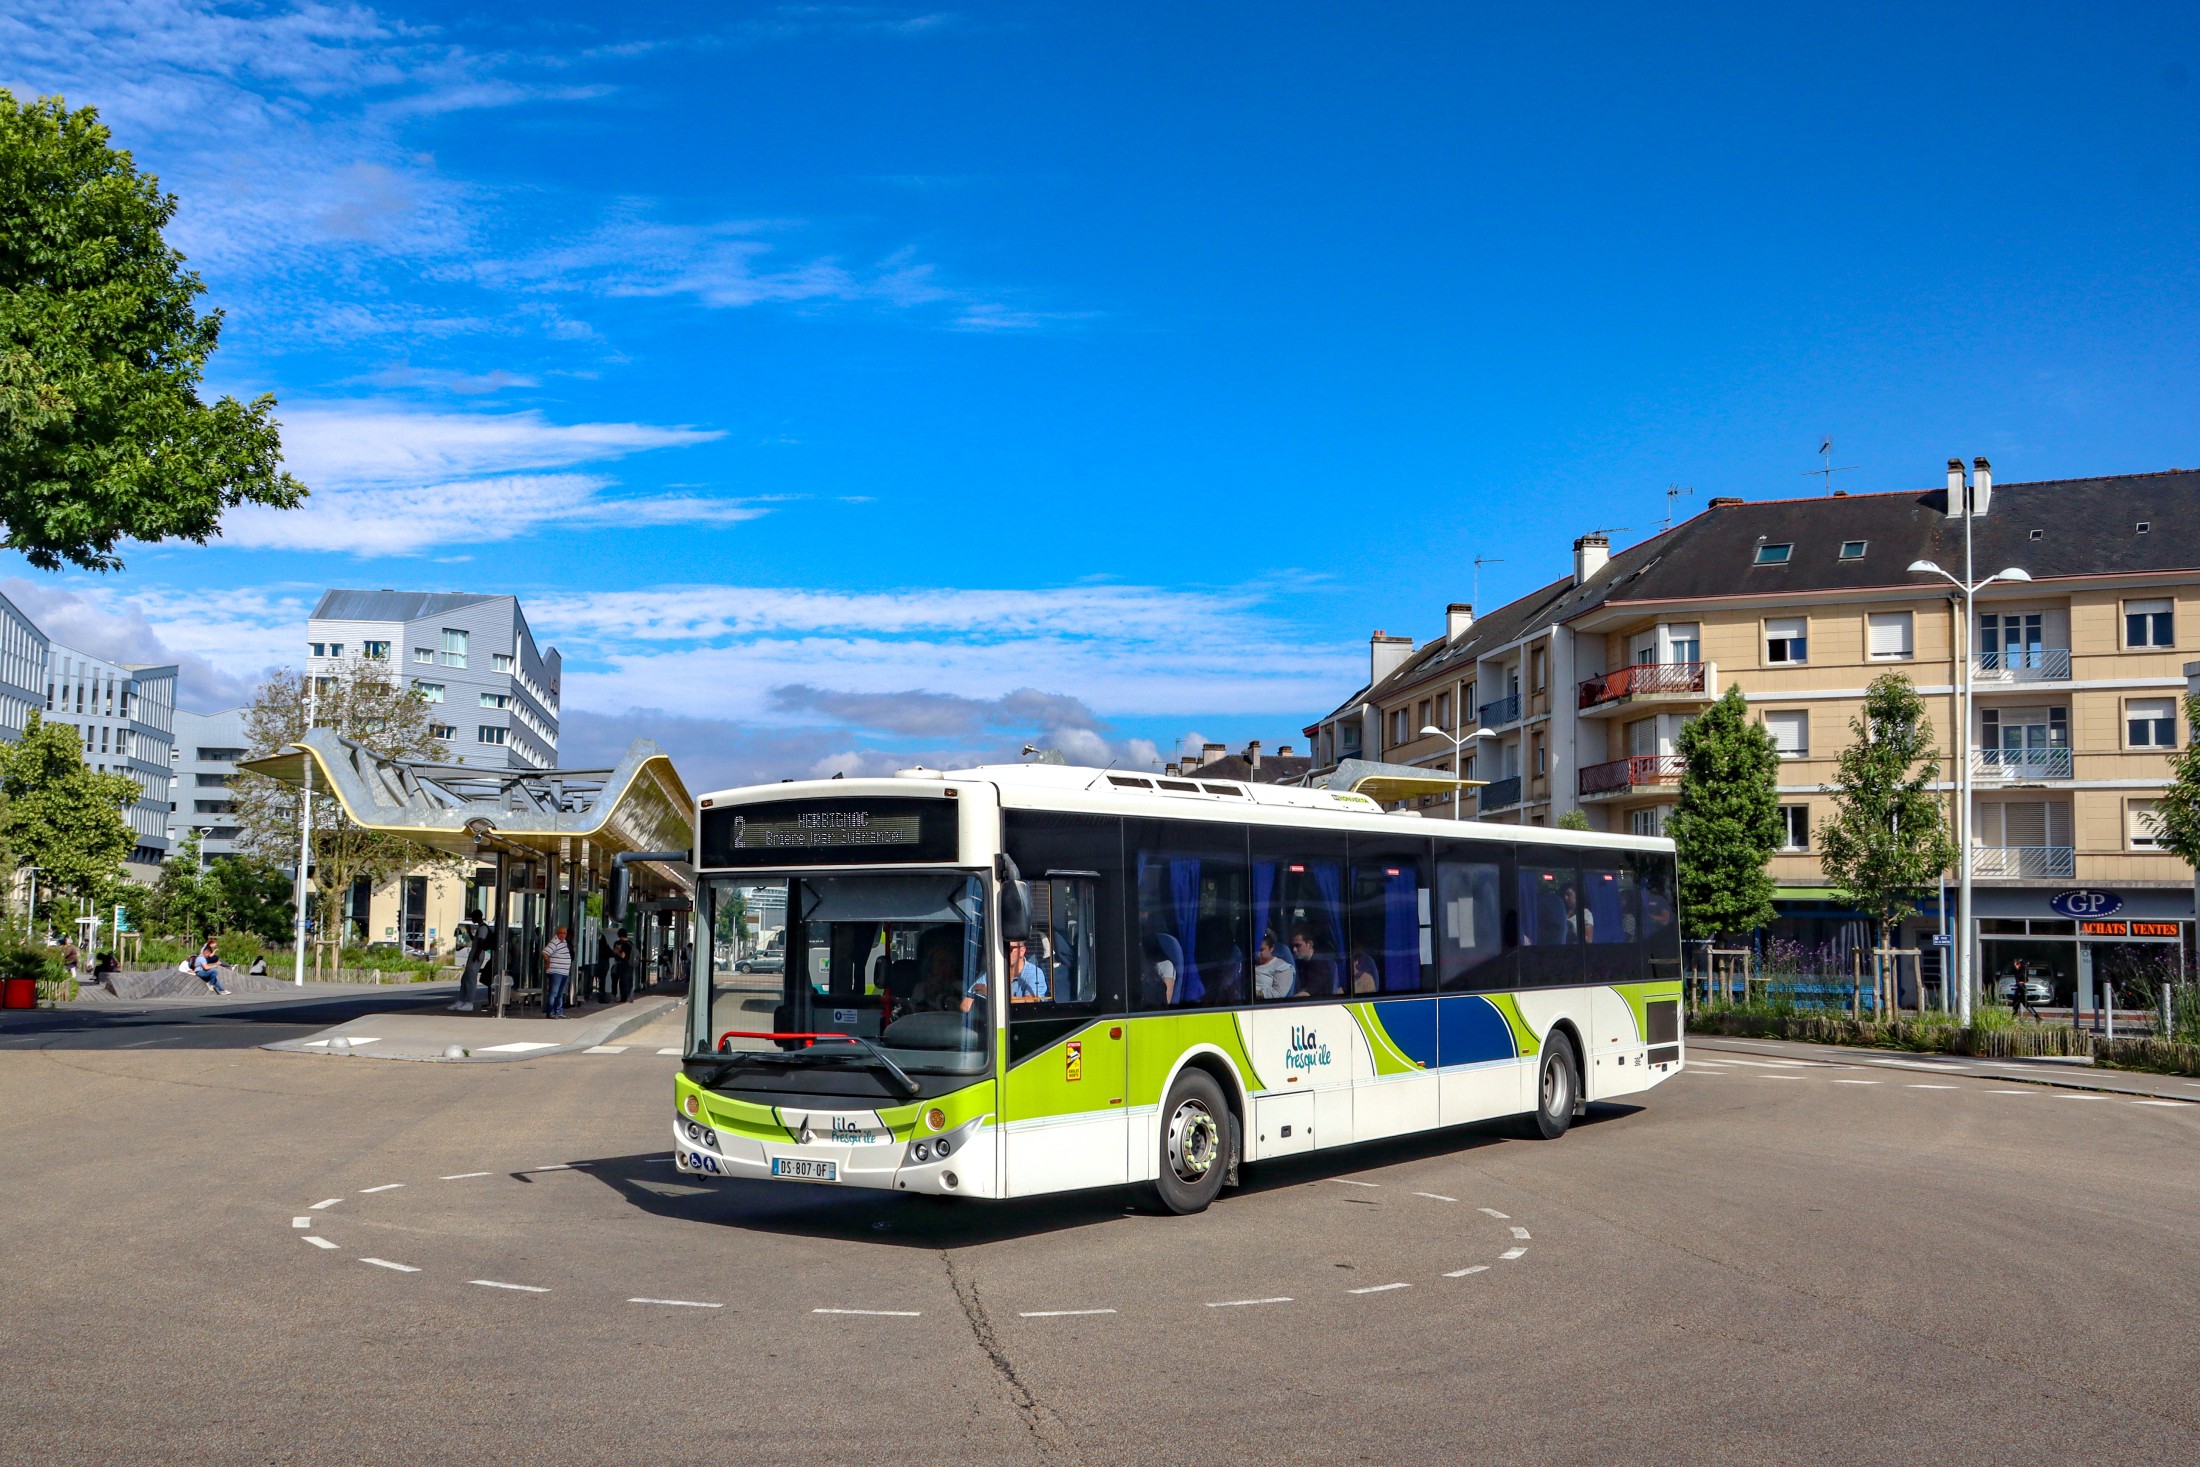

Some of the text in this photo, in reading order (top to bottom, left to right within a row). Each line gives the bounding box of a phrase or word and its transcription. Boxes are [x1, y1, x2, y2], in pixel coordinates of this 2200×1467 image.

[798, 811, 869, 829] HERBIGNAC
[734, 815, 746, 849] 2
[2067, 893, 2106, 913] GP
[2082, 922, 2178, 936] ACHATS VENTES
